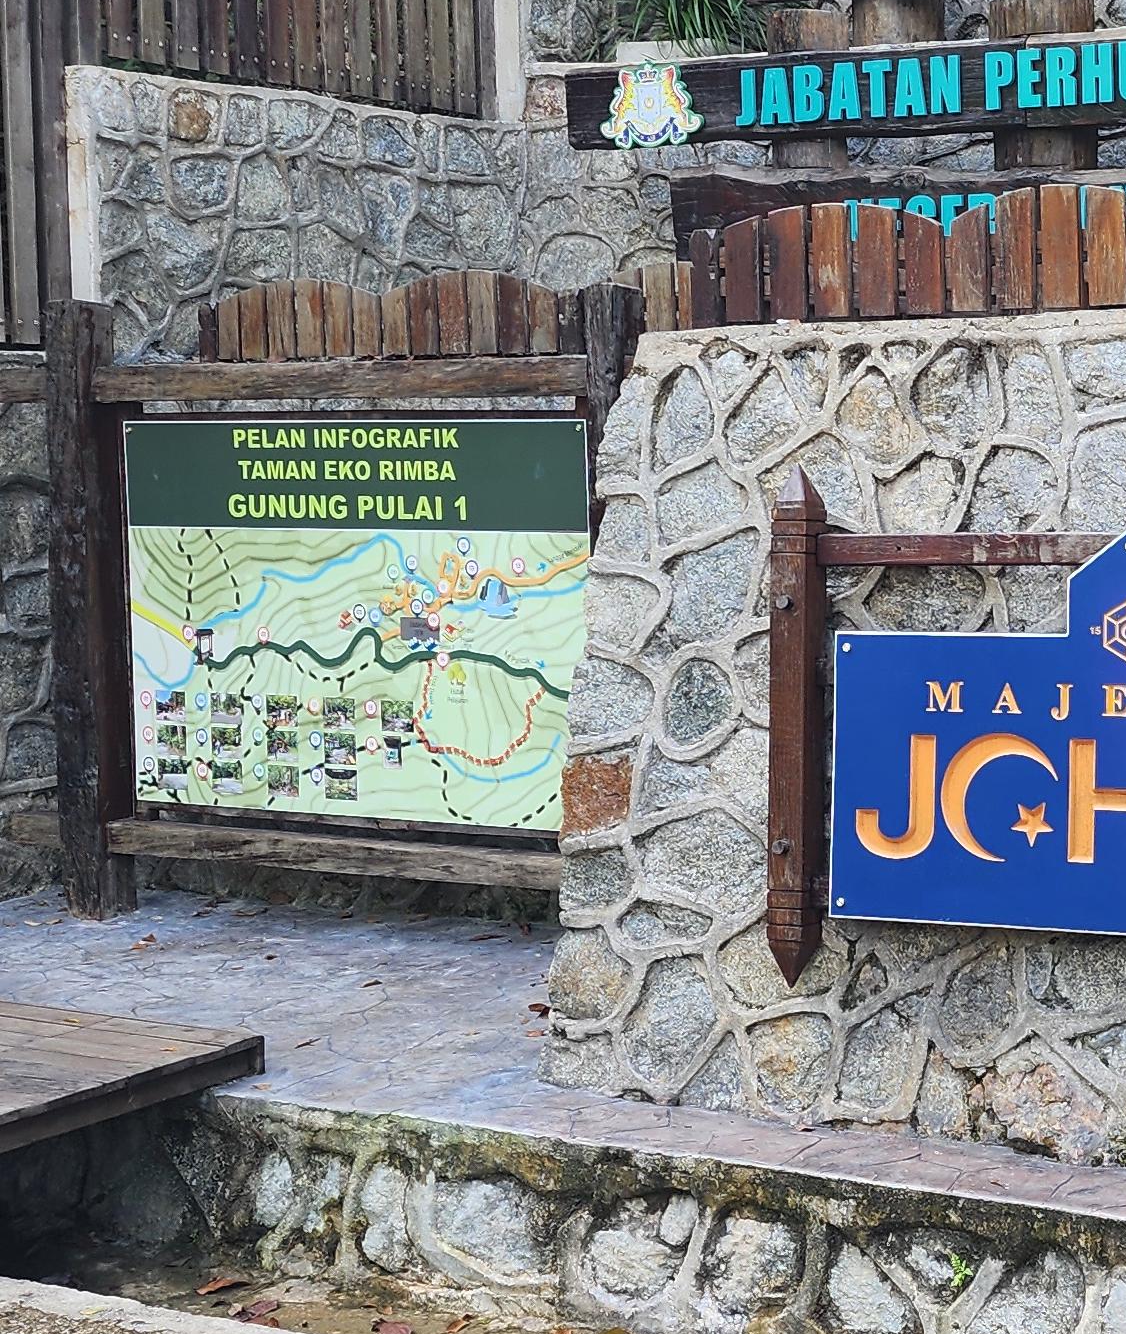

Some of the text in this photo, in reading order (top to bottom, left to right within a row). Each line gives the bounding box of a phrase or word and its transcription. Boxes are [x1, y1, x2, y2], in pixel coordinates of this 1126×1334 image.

[735, 53, 962, 127] JABATAN
[232, 427, 460, 449] PELAN INFOGRAFIK
[238, 460, 457, 482] TAMAN EKO RIMBA
[227, 493, 468, 521] GUNUNG PULAI 1
